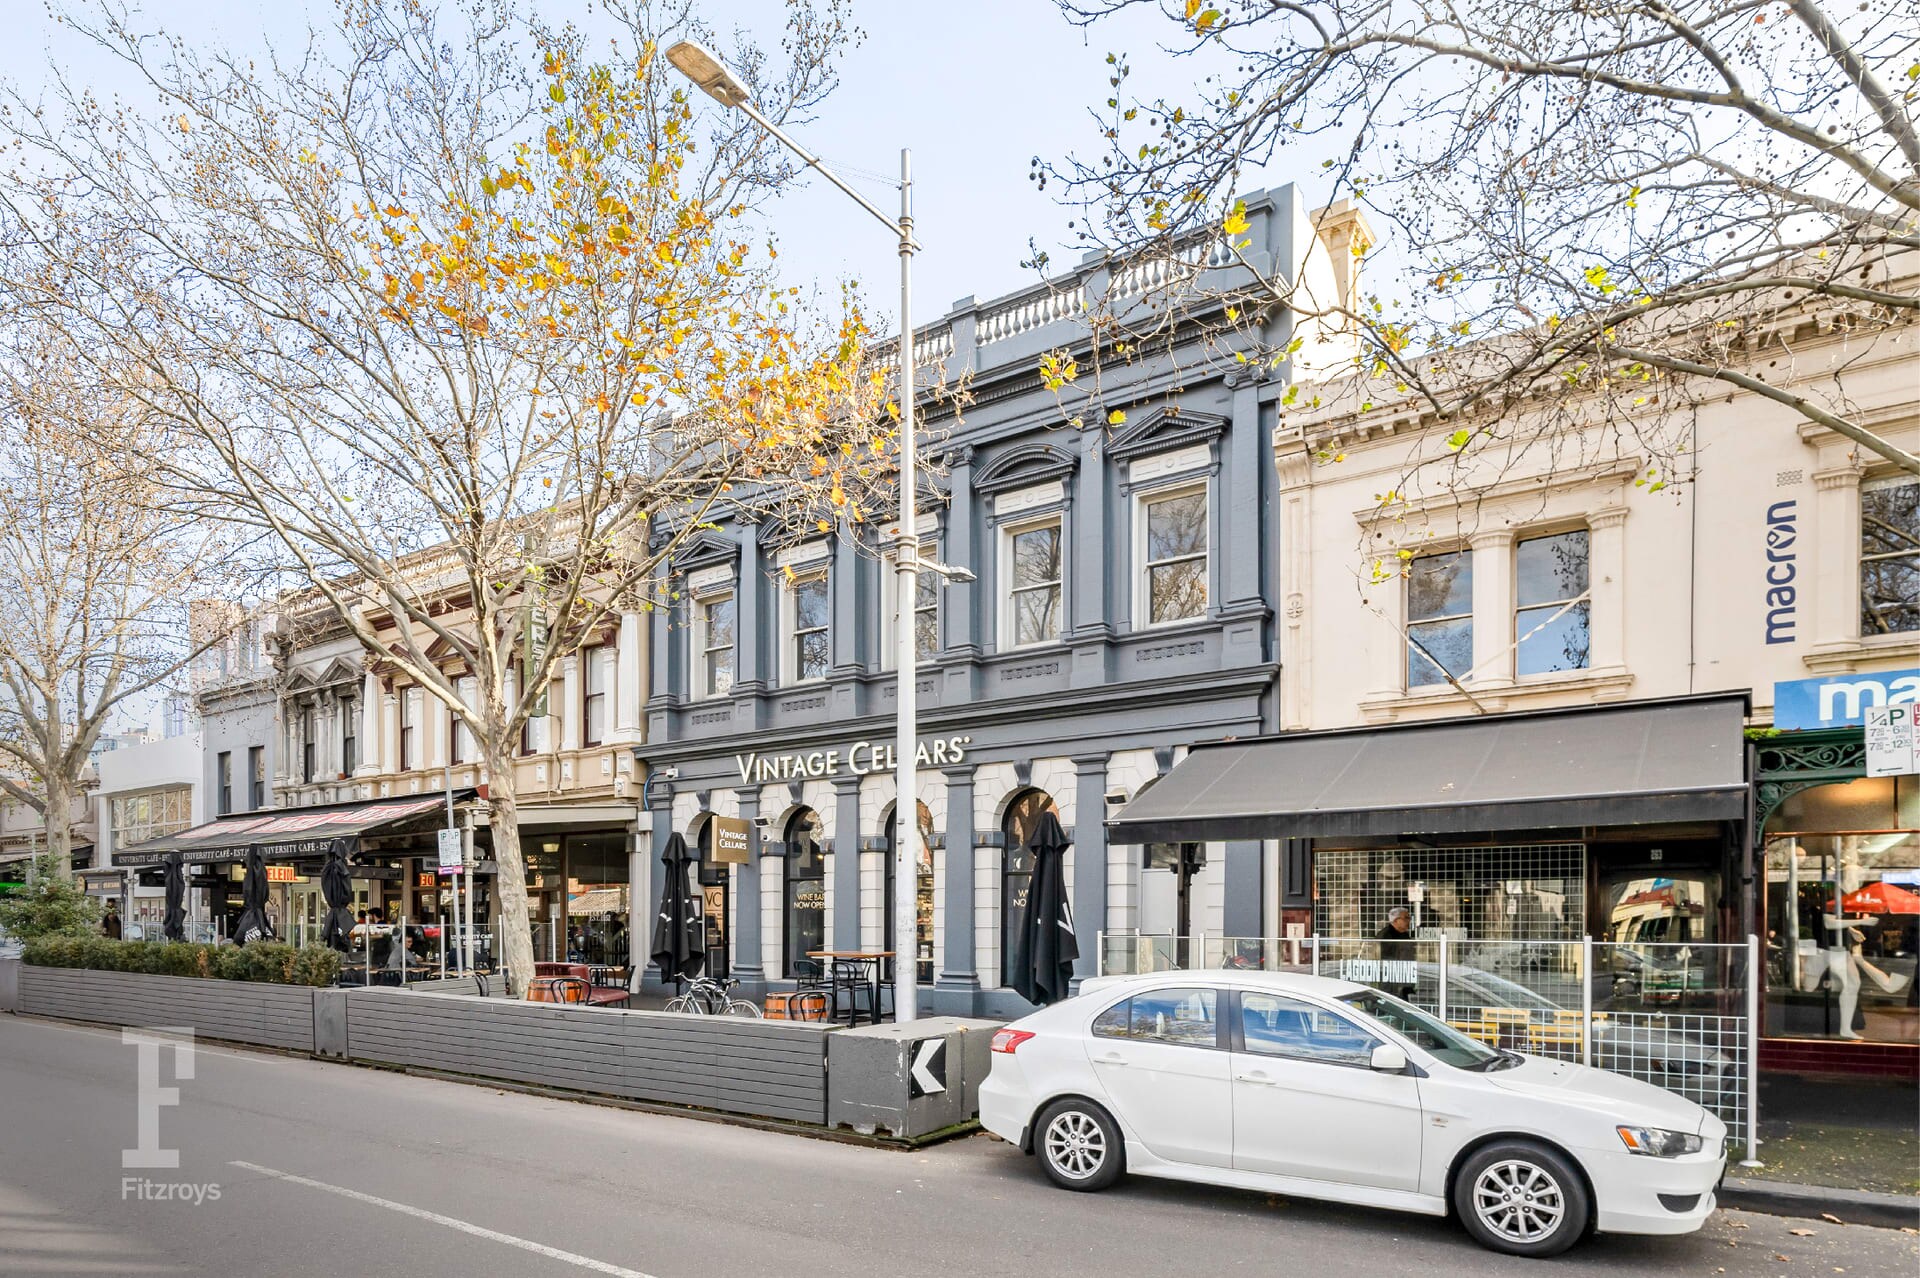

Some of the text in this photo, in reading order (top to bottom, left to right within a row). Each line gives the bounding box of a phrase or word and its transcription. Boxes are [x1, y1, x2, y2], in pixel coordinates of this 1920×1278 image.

[1765, 500, 1797, 645] macron
[736, 737, 967, 785] VINTAGE CELARS
[719, 829, 748, 841] VINTAGE
[262, 844, 297, 855] NIVERSITY
[719, 838, 747, 850] CELLARS
[705, 892, 722, 907] VC
[797, 893, 814, 901] WINE
[1340, 959, 1418, 983] LAGOON DINING
